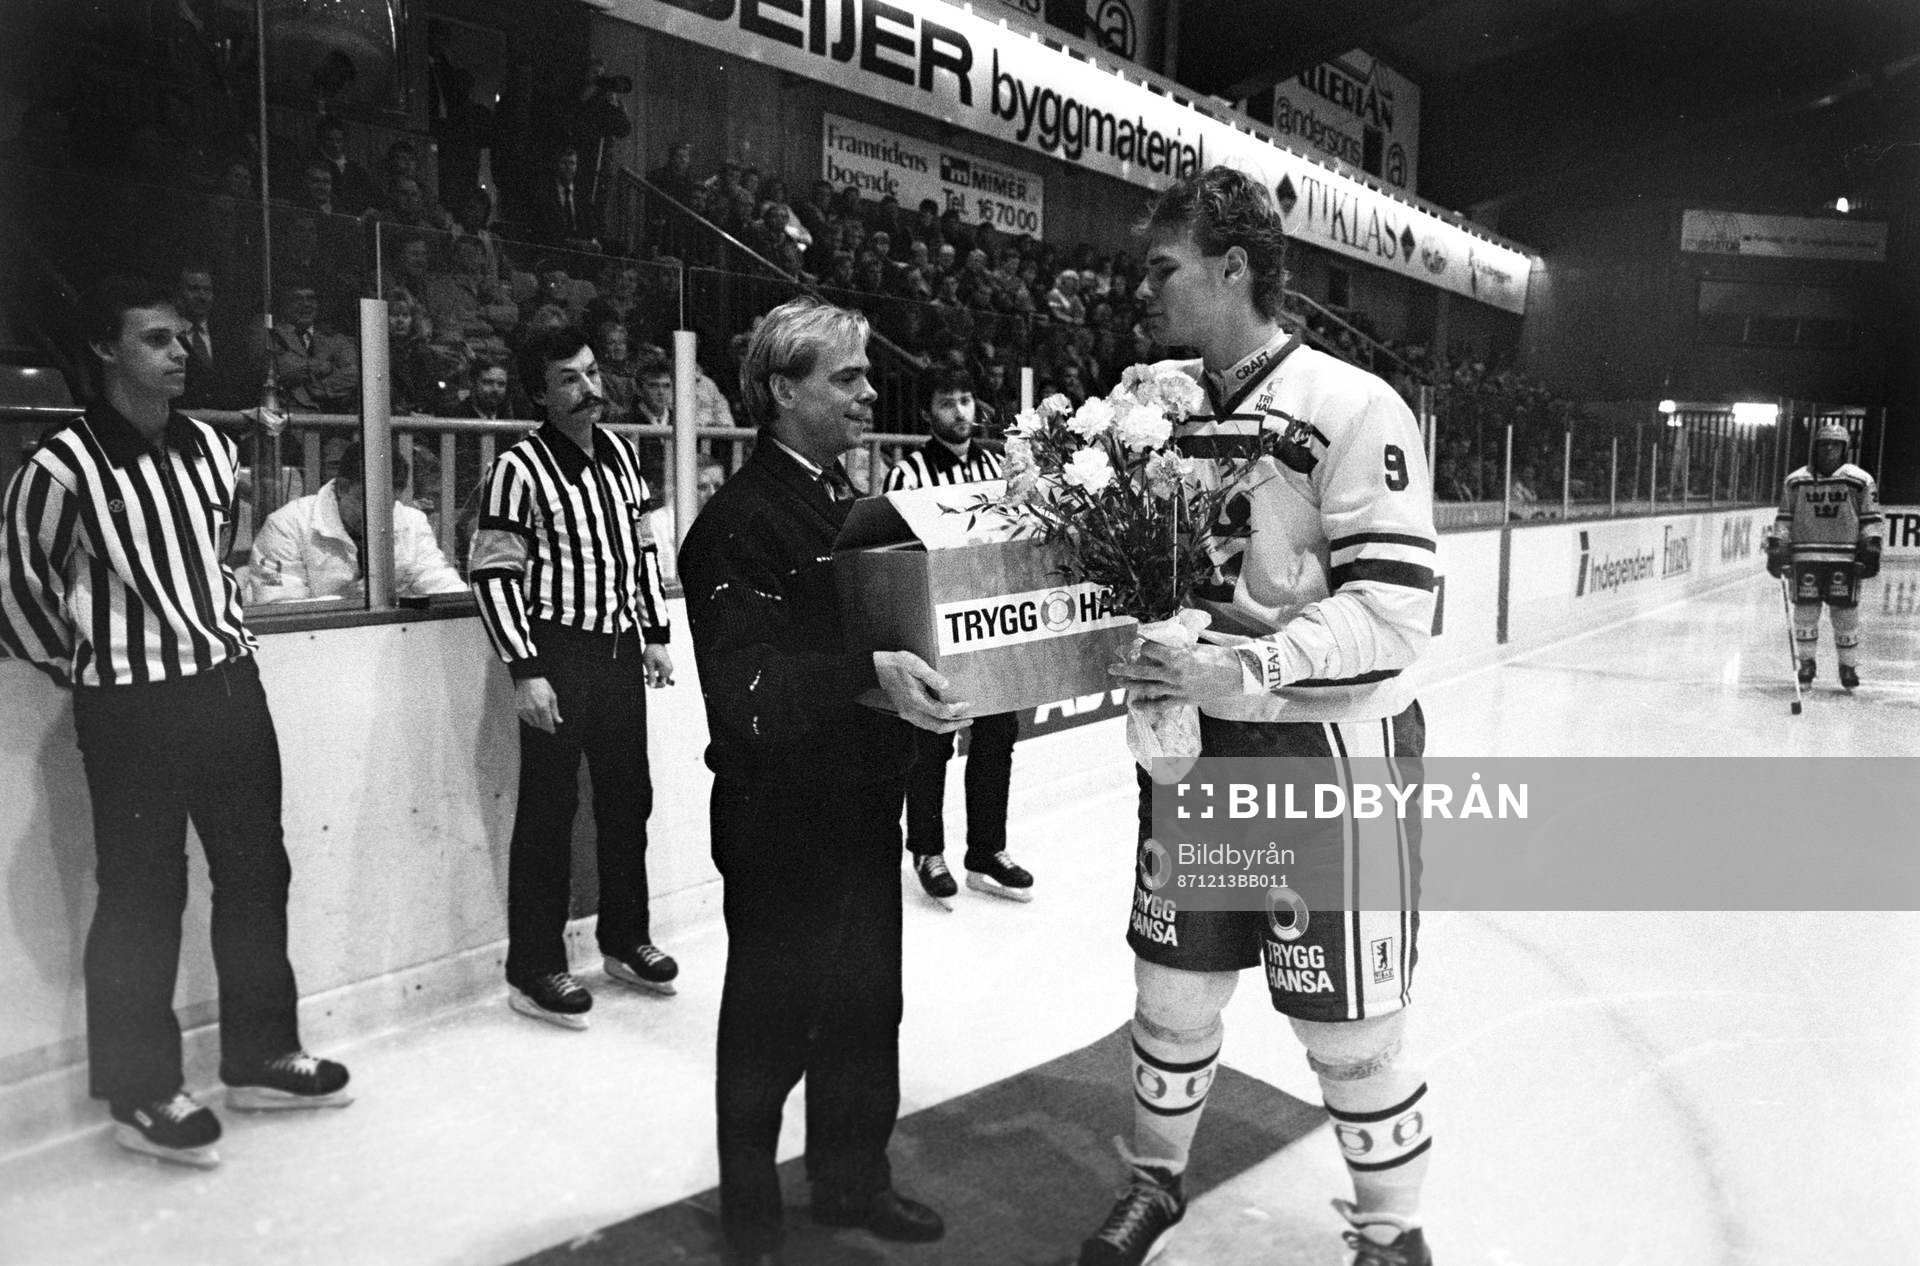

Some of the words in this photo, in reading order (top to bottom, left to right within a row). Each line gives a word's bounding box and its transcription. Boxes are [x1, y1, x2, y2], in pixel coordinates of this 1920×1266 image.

[657, 0, 973, 107] EIJER
[991, 48, 1203, 180] byggmaterial
[828, 125, 928, 173] Framtidens
[828, 155, 899, 196] boende
[1235, 350, 1271, 380] CRAFT
[1384, 444, 1410, 492] 9
[1885, 513, 1920, 547] TR
[1590, 547, 1655, 594] Independent
[945, 601, 1038, 643] TRYGG
[1266, 940, 1326, 969] TRYGG
[1269, 969, 1336, 994] HANSA
